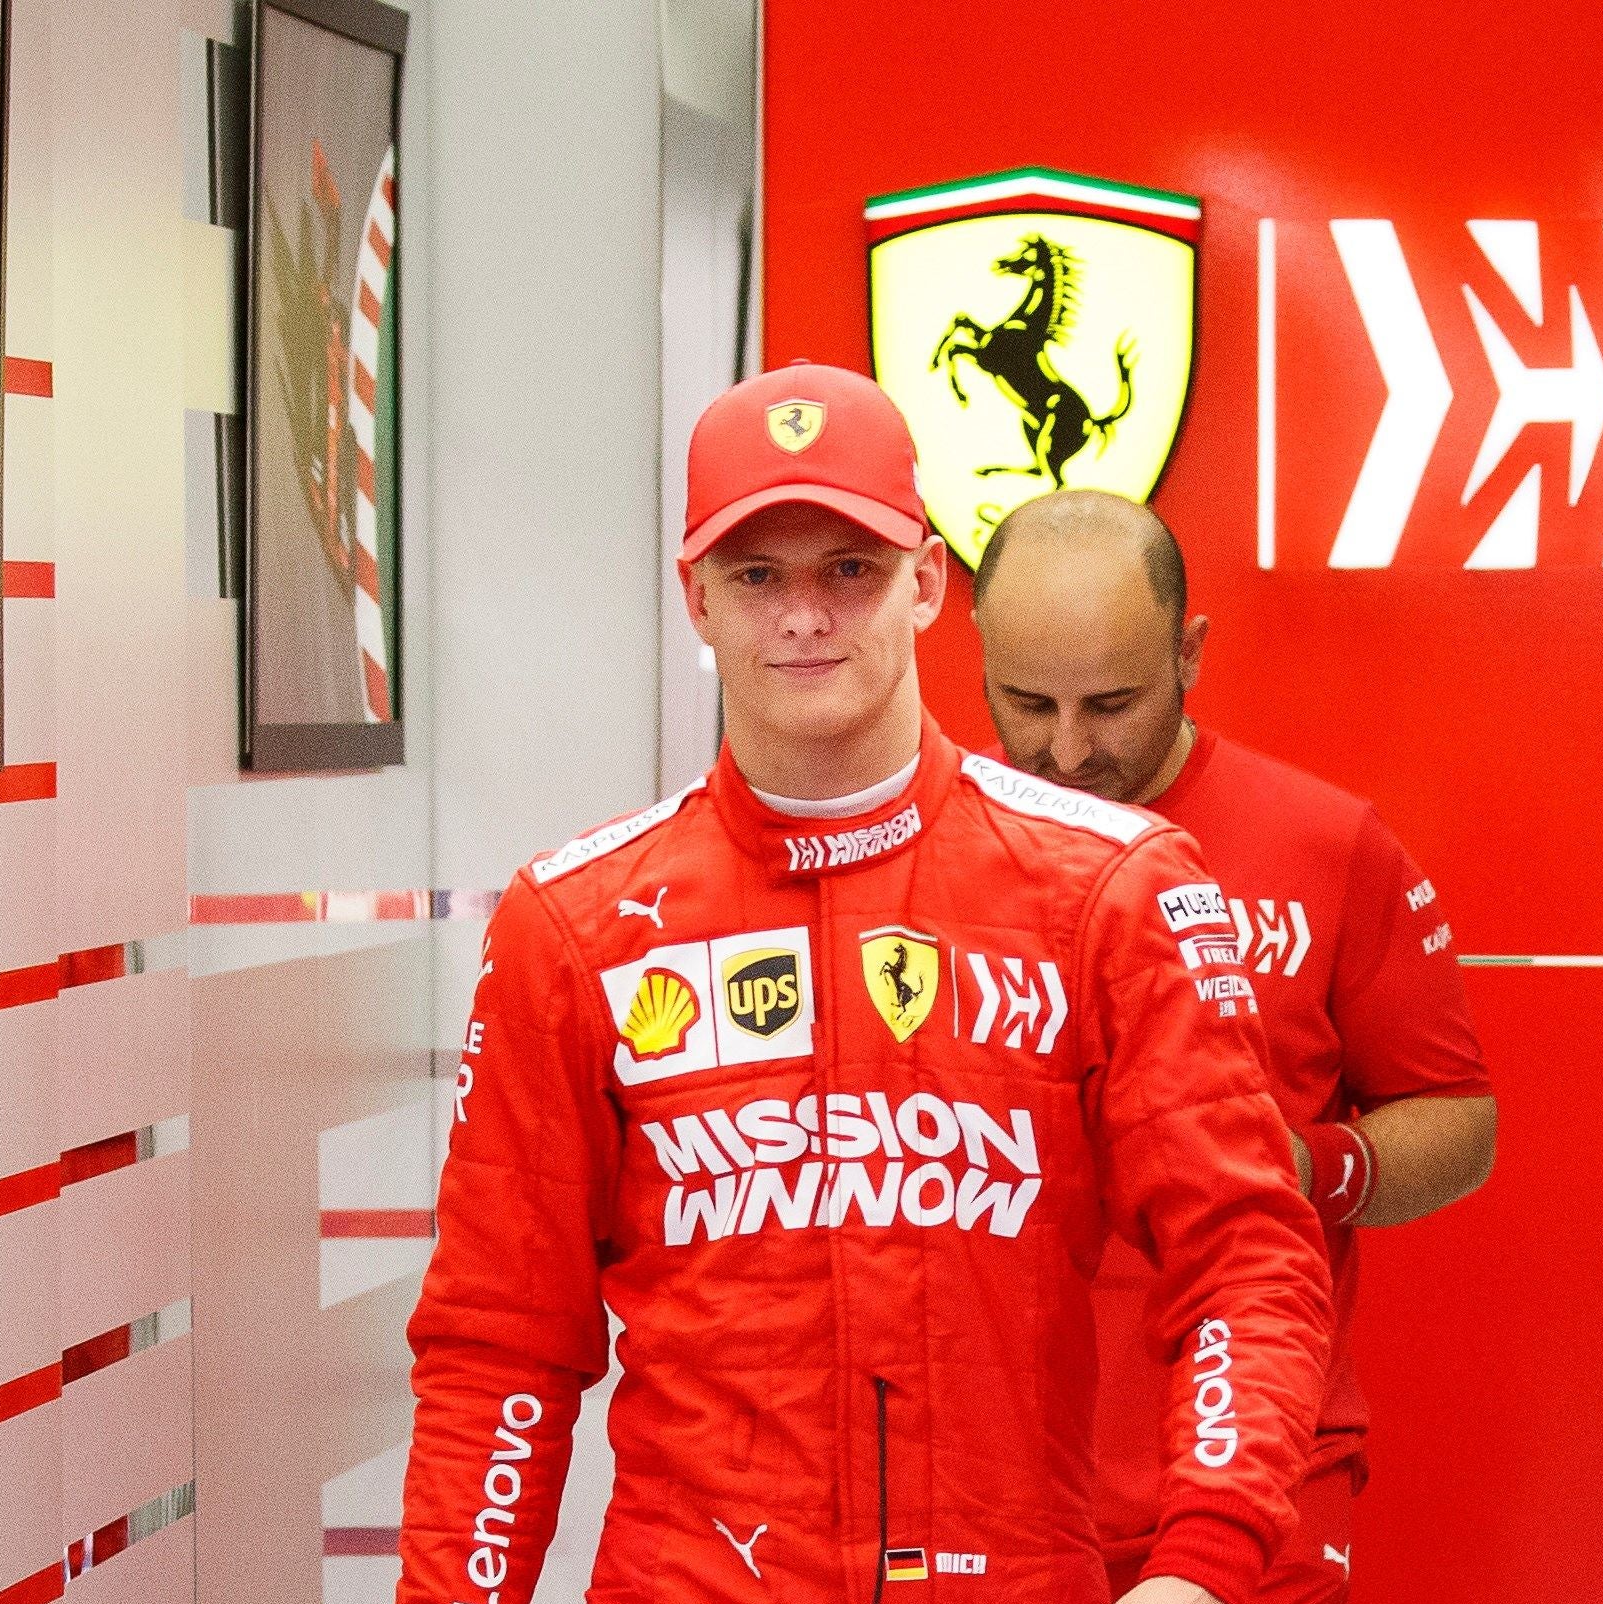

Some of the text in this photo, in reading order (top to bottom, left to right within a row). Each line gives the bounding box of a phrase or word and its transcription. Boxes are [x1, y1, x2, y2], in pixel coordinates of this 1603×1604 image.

[824, 802, 920, 850] MISSION
[729, 973, 798, 1027] ups
[640, 1091, 1042, 1182] MISSION
[663, 1160, 1043, 1247] WINNOW
[1193, 1317, 1239, 1468] enovo
